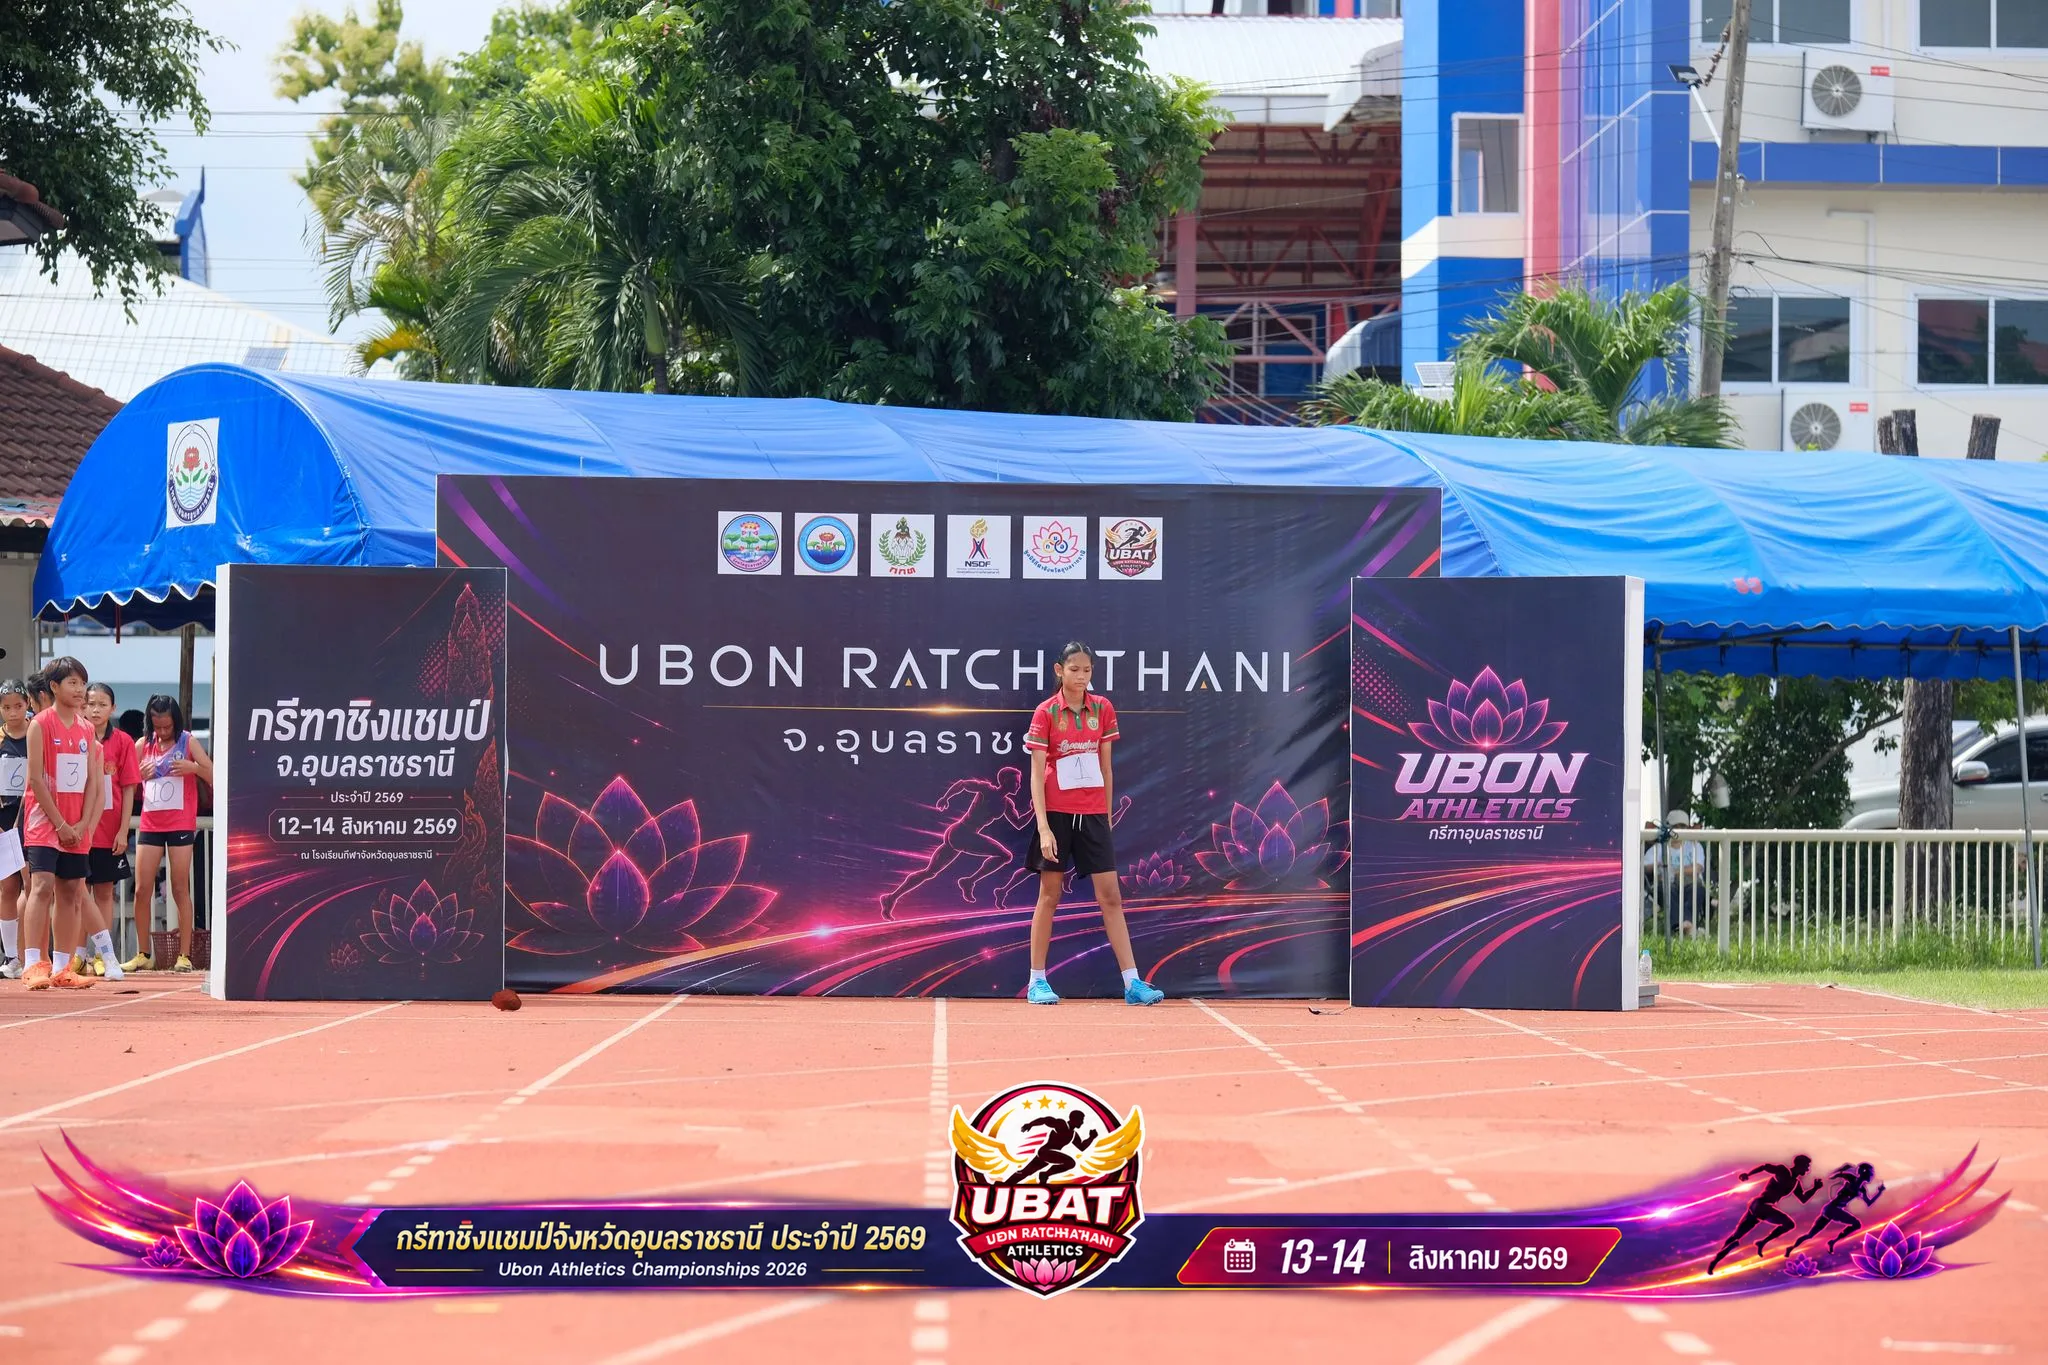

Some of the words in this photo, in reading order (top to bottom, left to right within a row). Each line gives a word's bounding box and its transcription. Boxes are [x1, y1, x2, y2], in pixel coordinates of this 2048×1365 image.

[965, 560, 991, 568] NSDF
[1109, 549, 1153, 560] UBAT
[599, 643, 803, 687] UBON
[843, 647, 1289, 692] RATCHTHANI
[10, 763, 25, 788] 6
[66, 762, 79, 787] 3
[276, 747, 456, 786] จ.อุบลราชธานี
[1074, 757, 1093, 780] 1
[1395, 753, 1589, 794] UBON
[149, 781, 175, 805] 10
[331, 790, 371, 803] ประจำปี
[375, 792, 404, 803] 2569
[1395, 798, 1582, 820] ATHLETICS
[341, 817, 407, 835] สิงหาคม
[413, 818, 458, 835] 2569
[300, 851, 309, 860] ณ
